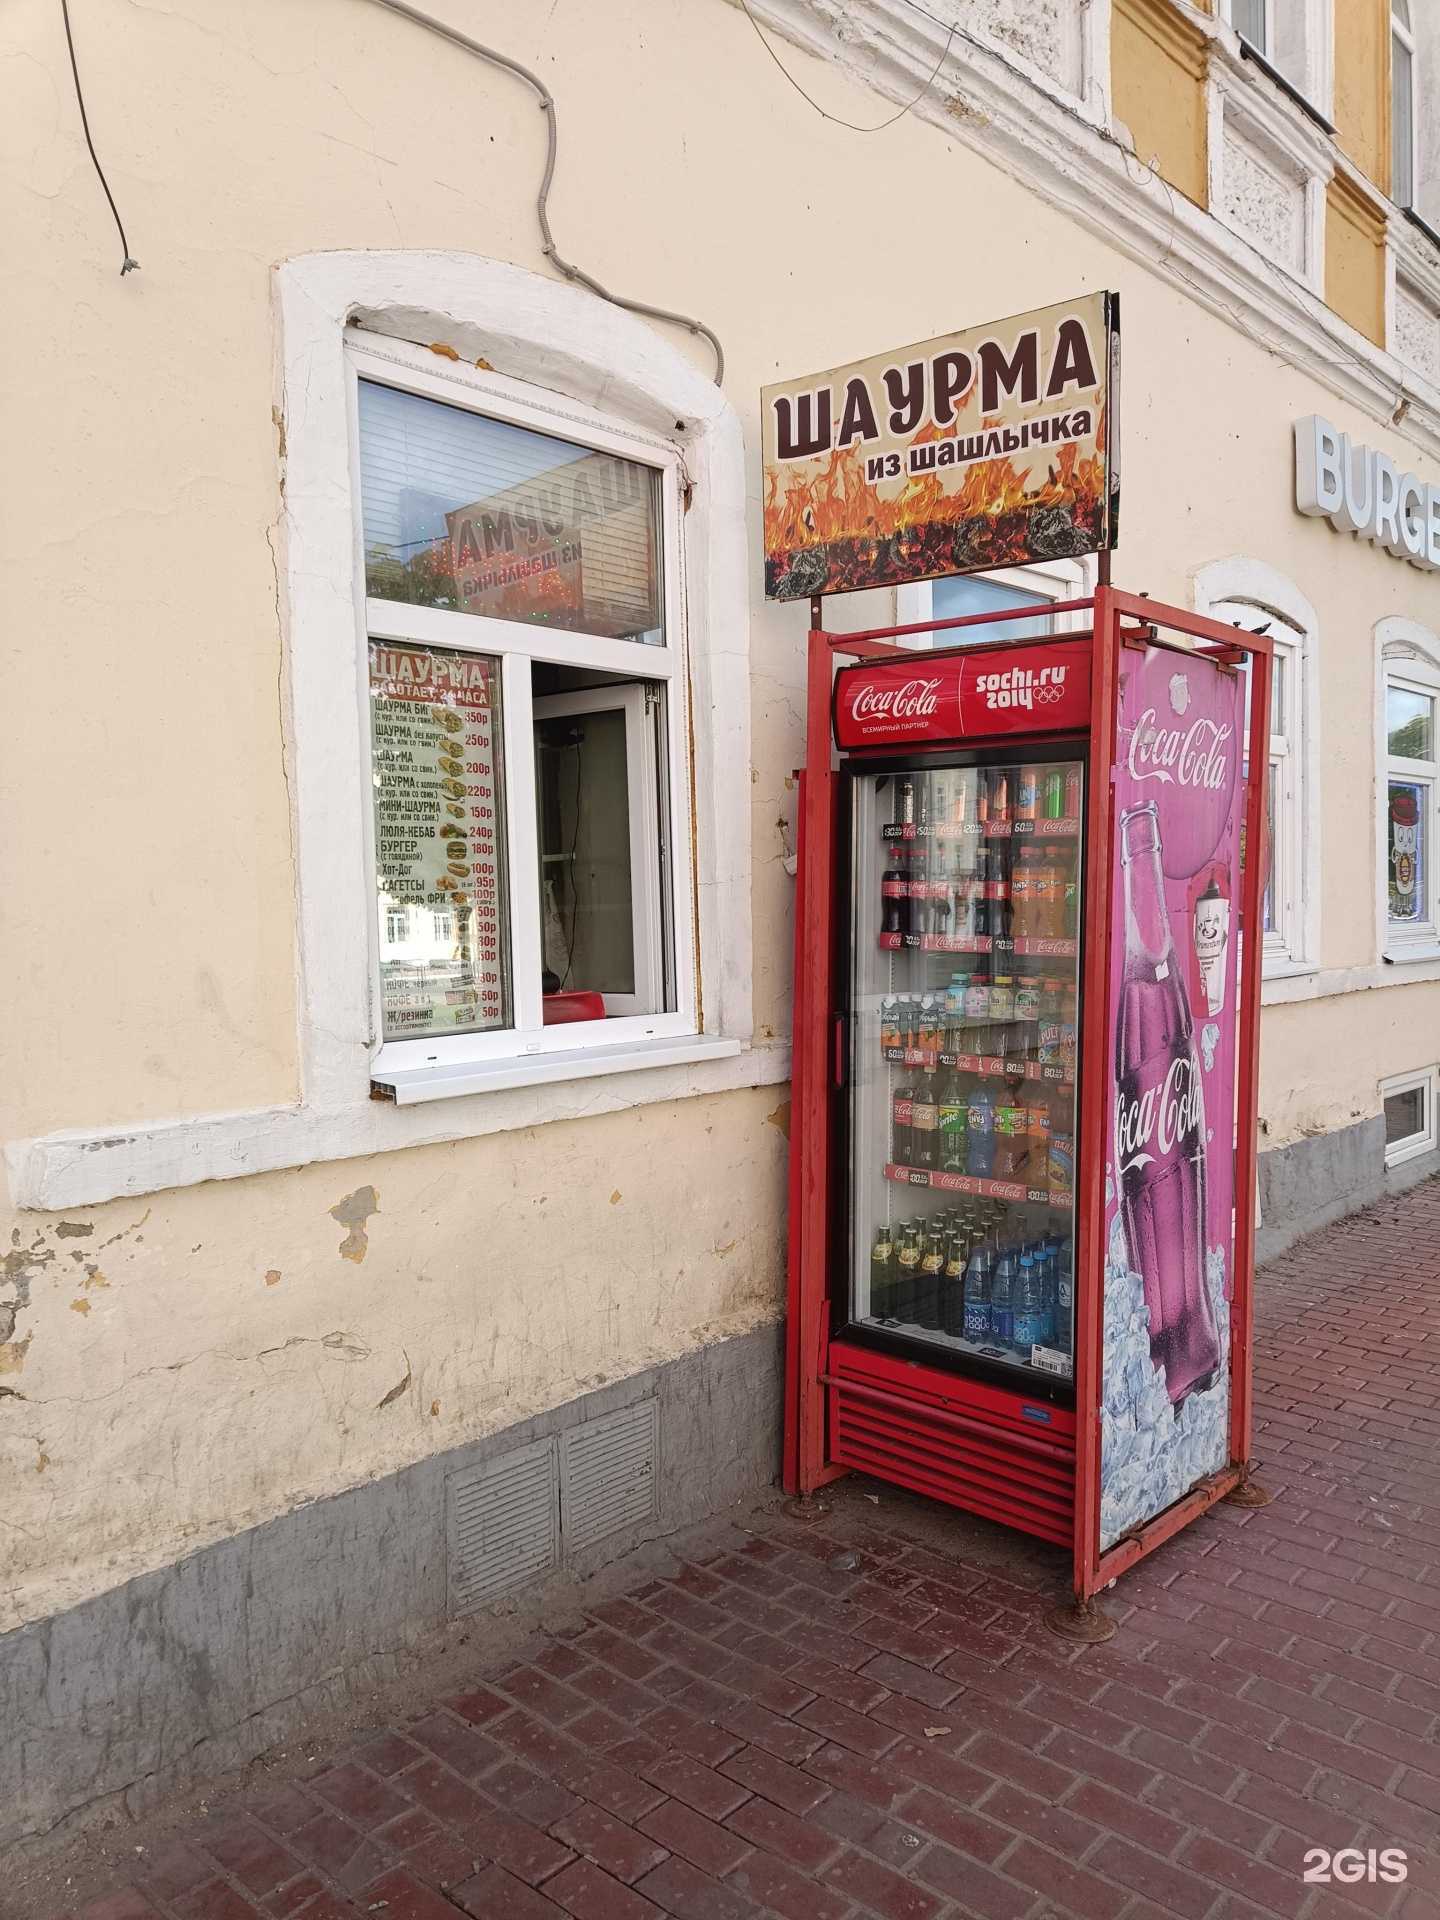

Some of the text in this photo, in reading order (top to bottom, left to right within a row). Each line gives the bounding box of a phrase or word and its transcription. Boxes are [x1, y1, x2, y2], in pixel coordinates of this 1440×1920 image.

[774, 319, 1098, 460] ШАУРМА
[867, 410, 1092, 481] из шашлычка
[1296, 414, 1440, 569] BURGE
[371, 652, 486, 690] ШАУРМА
[976, 665, 1066, 693] sochi.ru
[852, 677, 944, 722] Coca-Cola
[374, 700, 412, 713] ШАУРМА
[414, 703, 430, 715] БИГ
[862, 721, 929, 734] ВСЕМИРНЫЙ ПАРТНЕР
[375, 724, 412, 737] ШАУРМА
[465, 734, 489, 747] 250р
[1128, 708, 1232, 790] Coca-Cola
[466, 762, 490, 775] 200р
[467, 785, 491, 798] 220р
[379, 800, 492, 819] МИНИ-ШАУРМА 150р
[380, 826, 493, 840] ЛЮЛЯ-КЕБАБ 240р
[380, 840, 494, 856] БУРГЕР 180р
[382, 863, 494, 876] Хот-Дог 100р
[477, 877, 495, 888] 95р
[427, 892, 446, 904] ФРИ
[472, 890, 496, 902] 100р
[477, 907, 496, 918] 50р
[479, 922, 497, 933] 50р
[481, 991, 499, 1002] 50р
[482, 1007, 499, 1018] 50р
